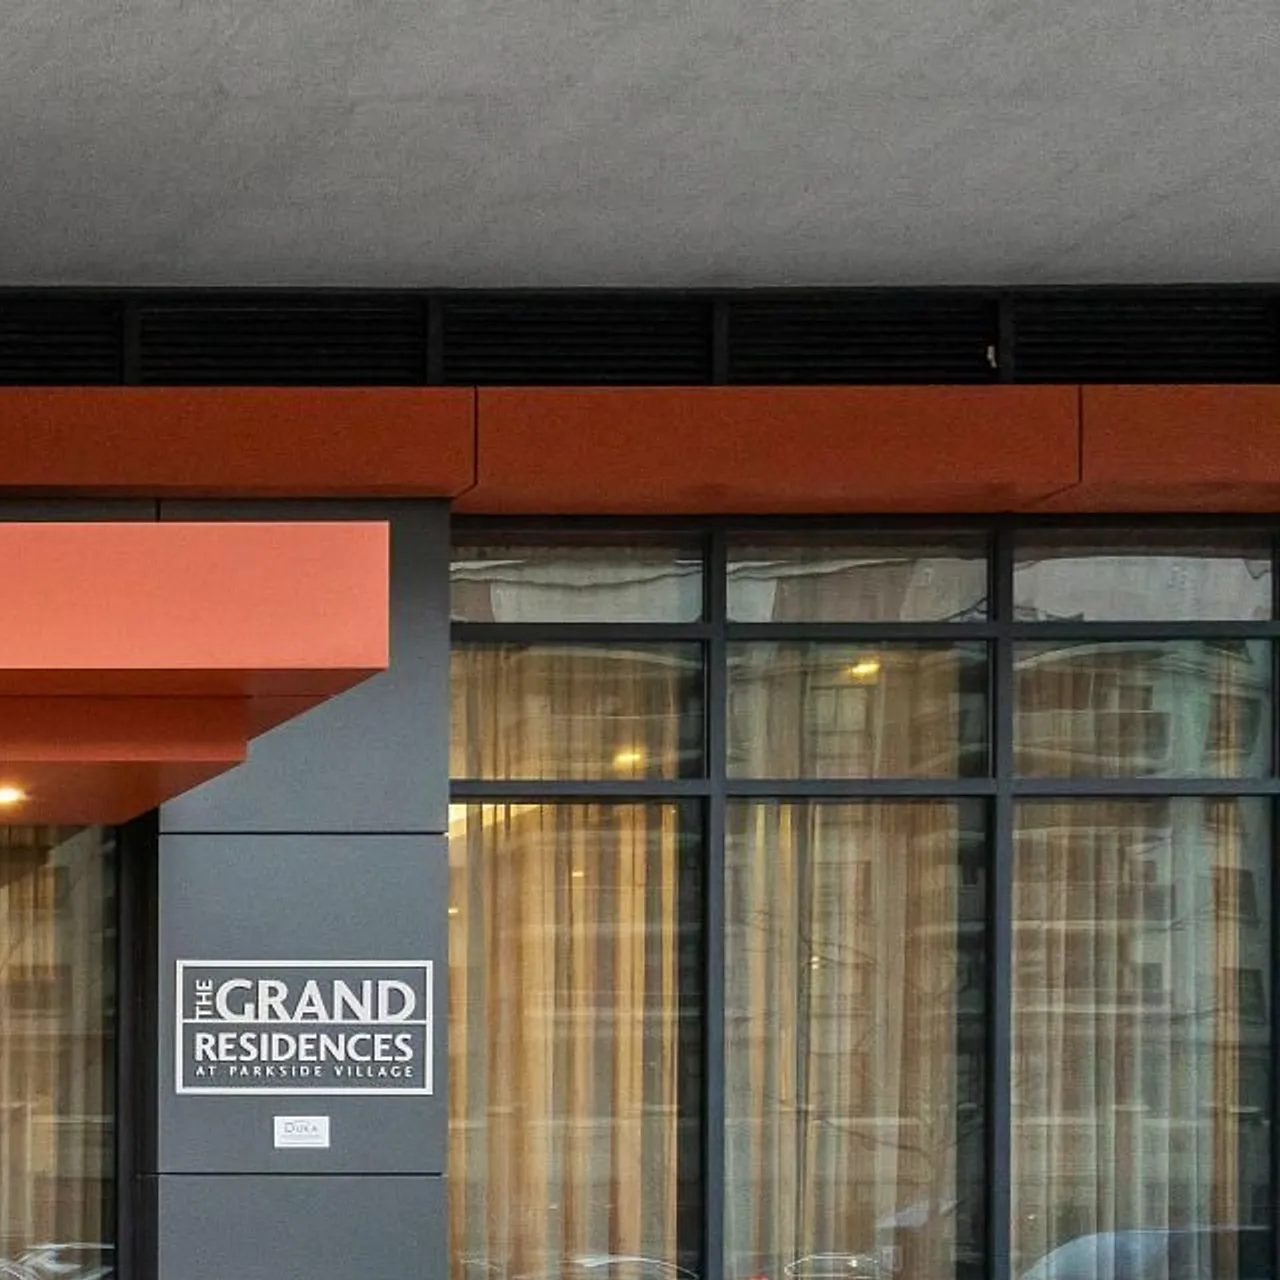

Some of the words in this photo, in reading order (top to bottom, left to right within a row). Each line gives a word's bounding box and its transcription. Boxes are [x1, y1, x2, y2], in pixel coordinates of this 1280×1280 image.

[196, 979, 213, 1020] THE
[215, 978, 416, 1022] GRAND
[195, 1032, 414, 1062] RESIDENCES
[196, 1065, 217, 1077] AT
[229, 1065, 322, 1077] PARKSIDE
[334, 1065, 414, 1077] VILLAGE
